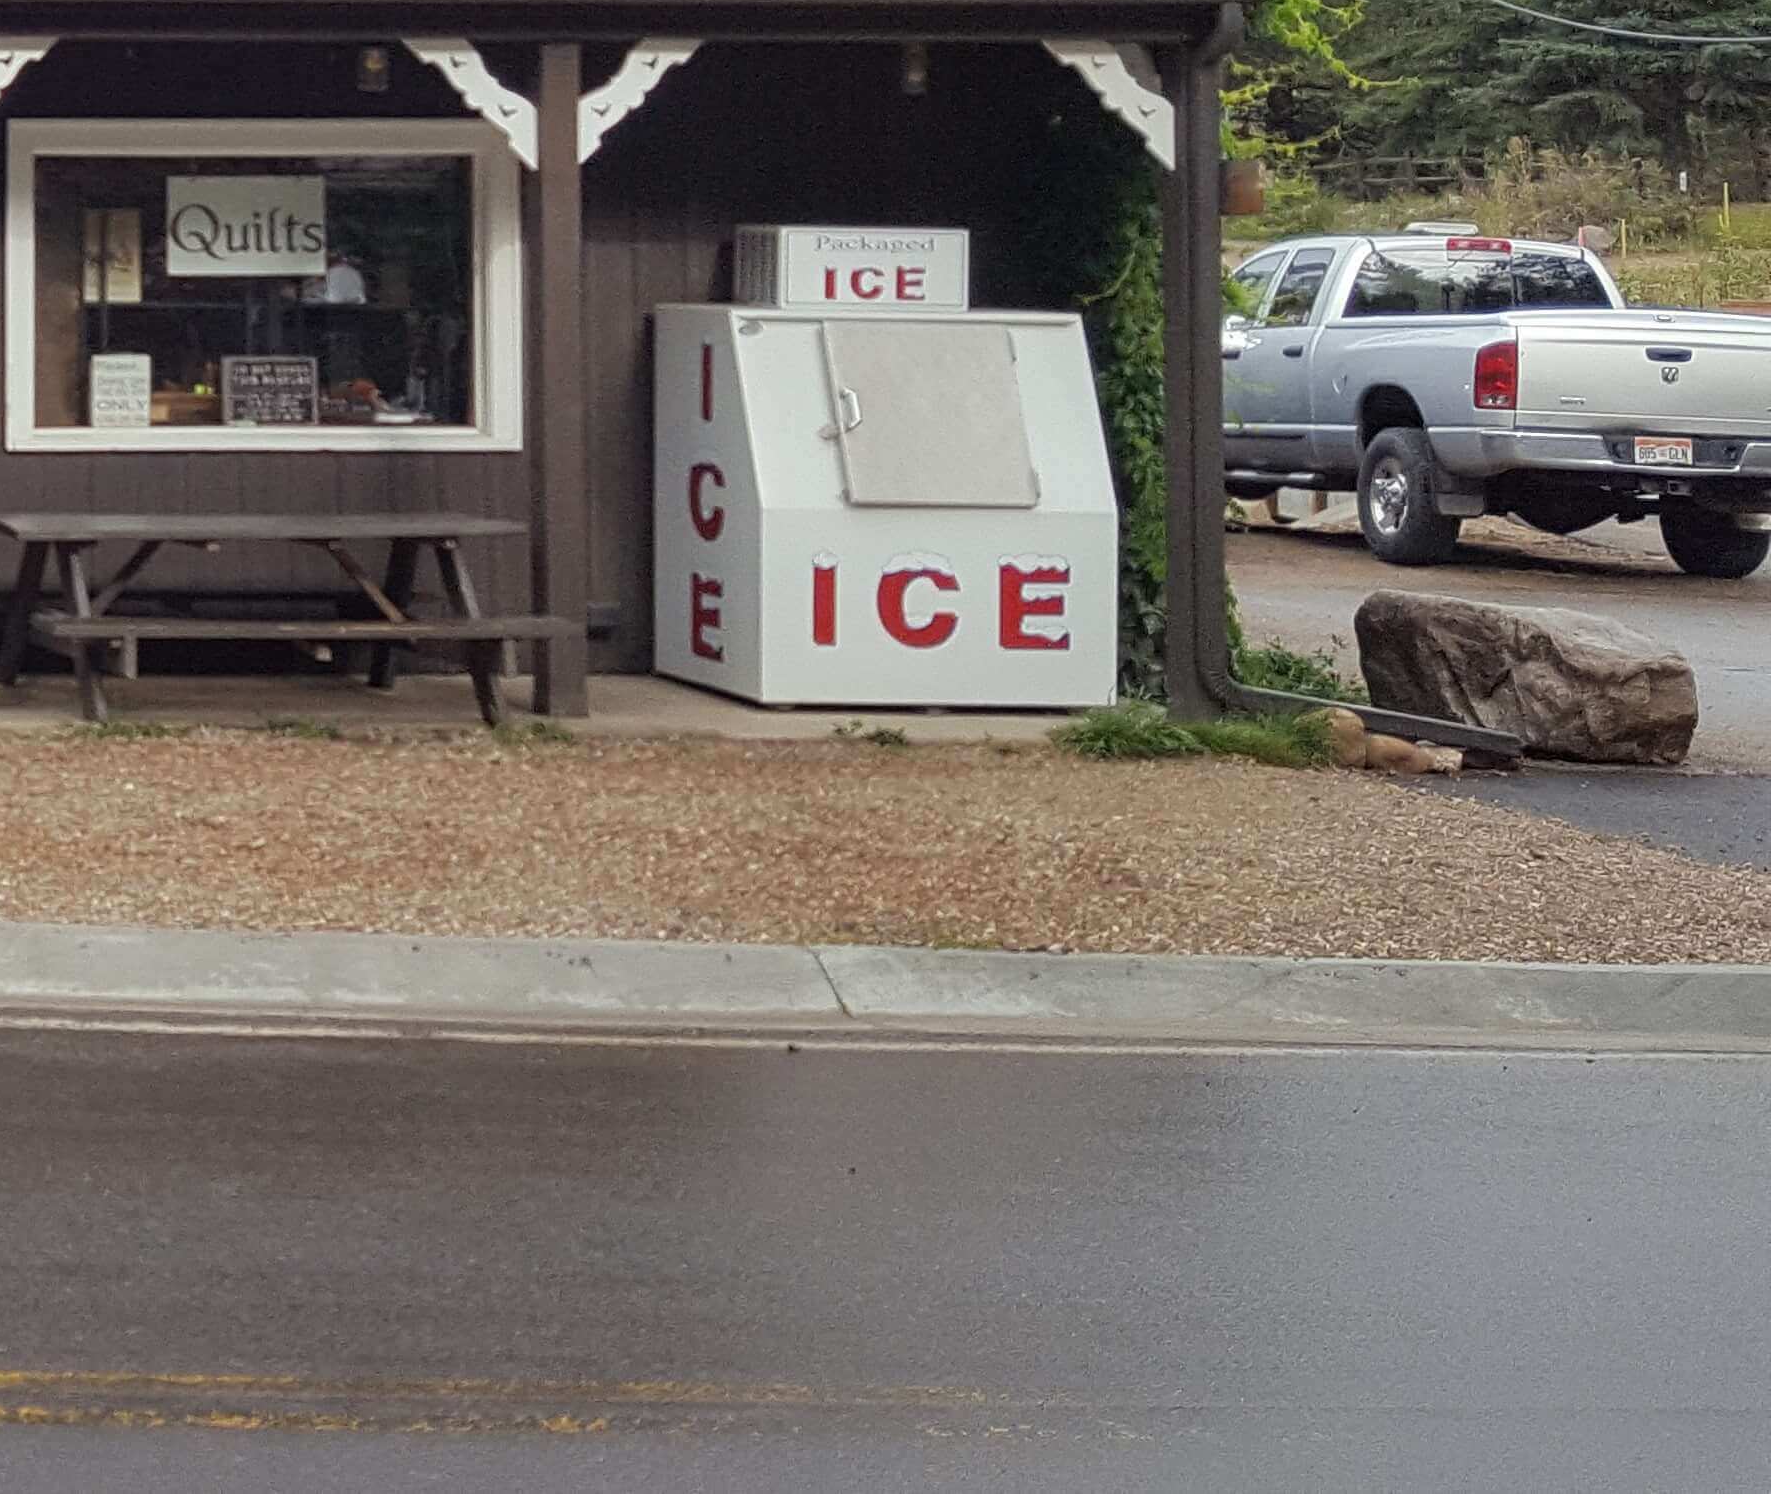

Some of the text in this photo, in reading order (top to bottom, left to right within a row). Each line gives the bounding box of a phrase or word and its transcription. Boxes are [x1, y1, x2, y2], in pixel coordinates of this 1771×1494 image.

[170, 204, 323, 261] Quilts
[814, 235, 934, 253] Packaged
[824, 266, 925, 300] ICE
[687, 342, 725, 662] ICE
[812, 551, 1072, 651] ICE
